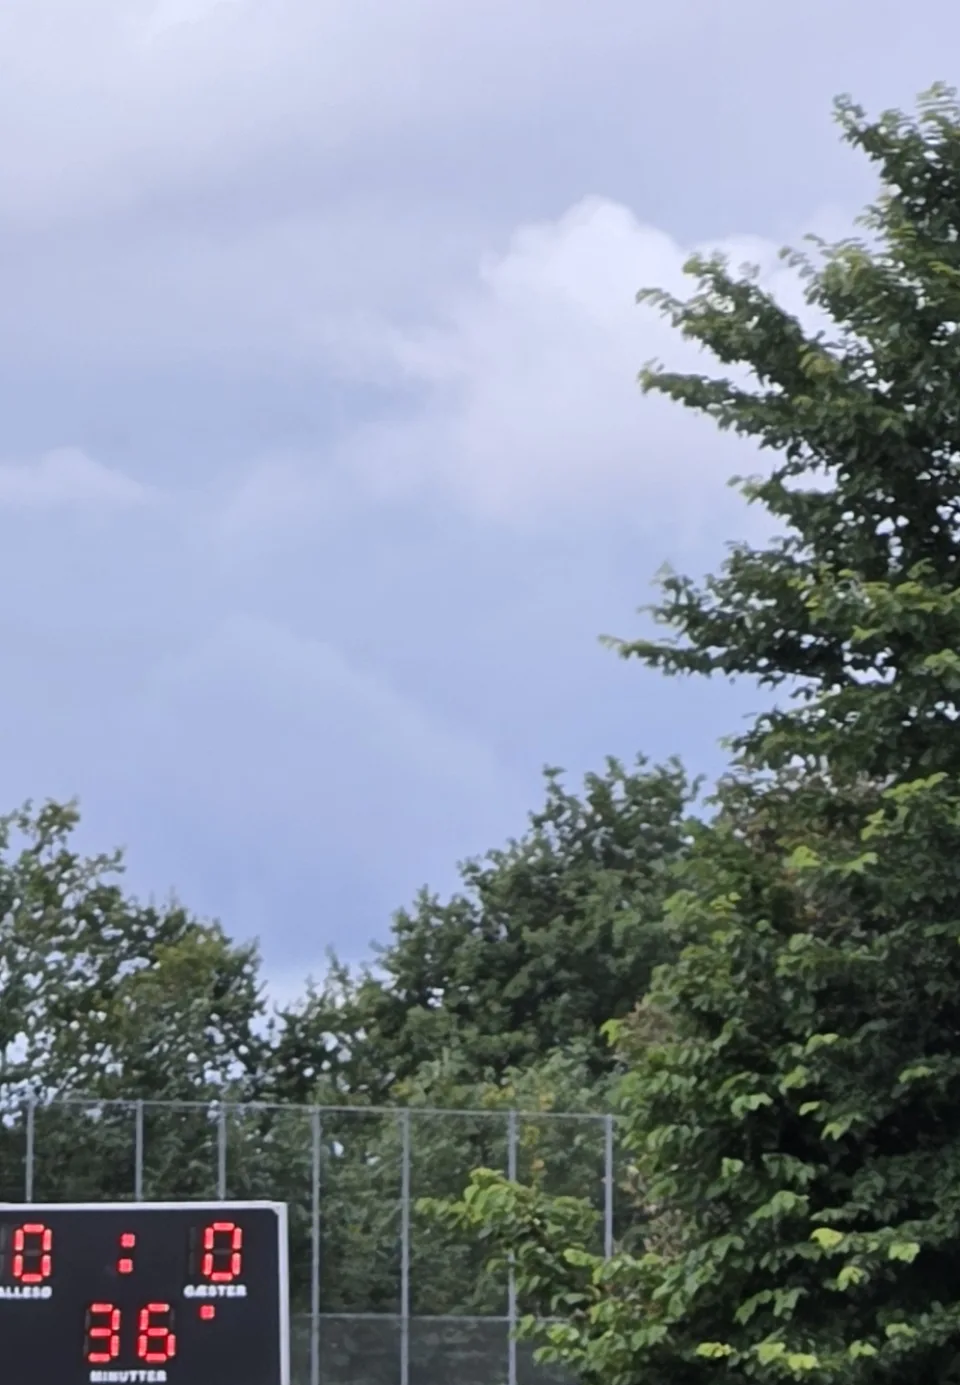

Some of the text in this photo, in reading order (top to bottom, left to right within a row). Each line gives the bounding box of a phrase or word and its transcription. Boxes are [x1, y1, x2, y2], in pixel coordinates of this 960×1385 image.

[13, 1222, 53, 1283] 0
[202, 1221, 243, 1282] 0
[87, 1303, 177, 1363] 36
[89, 1370, 168, 1383] MINUTTER
